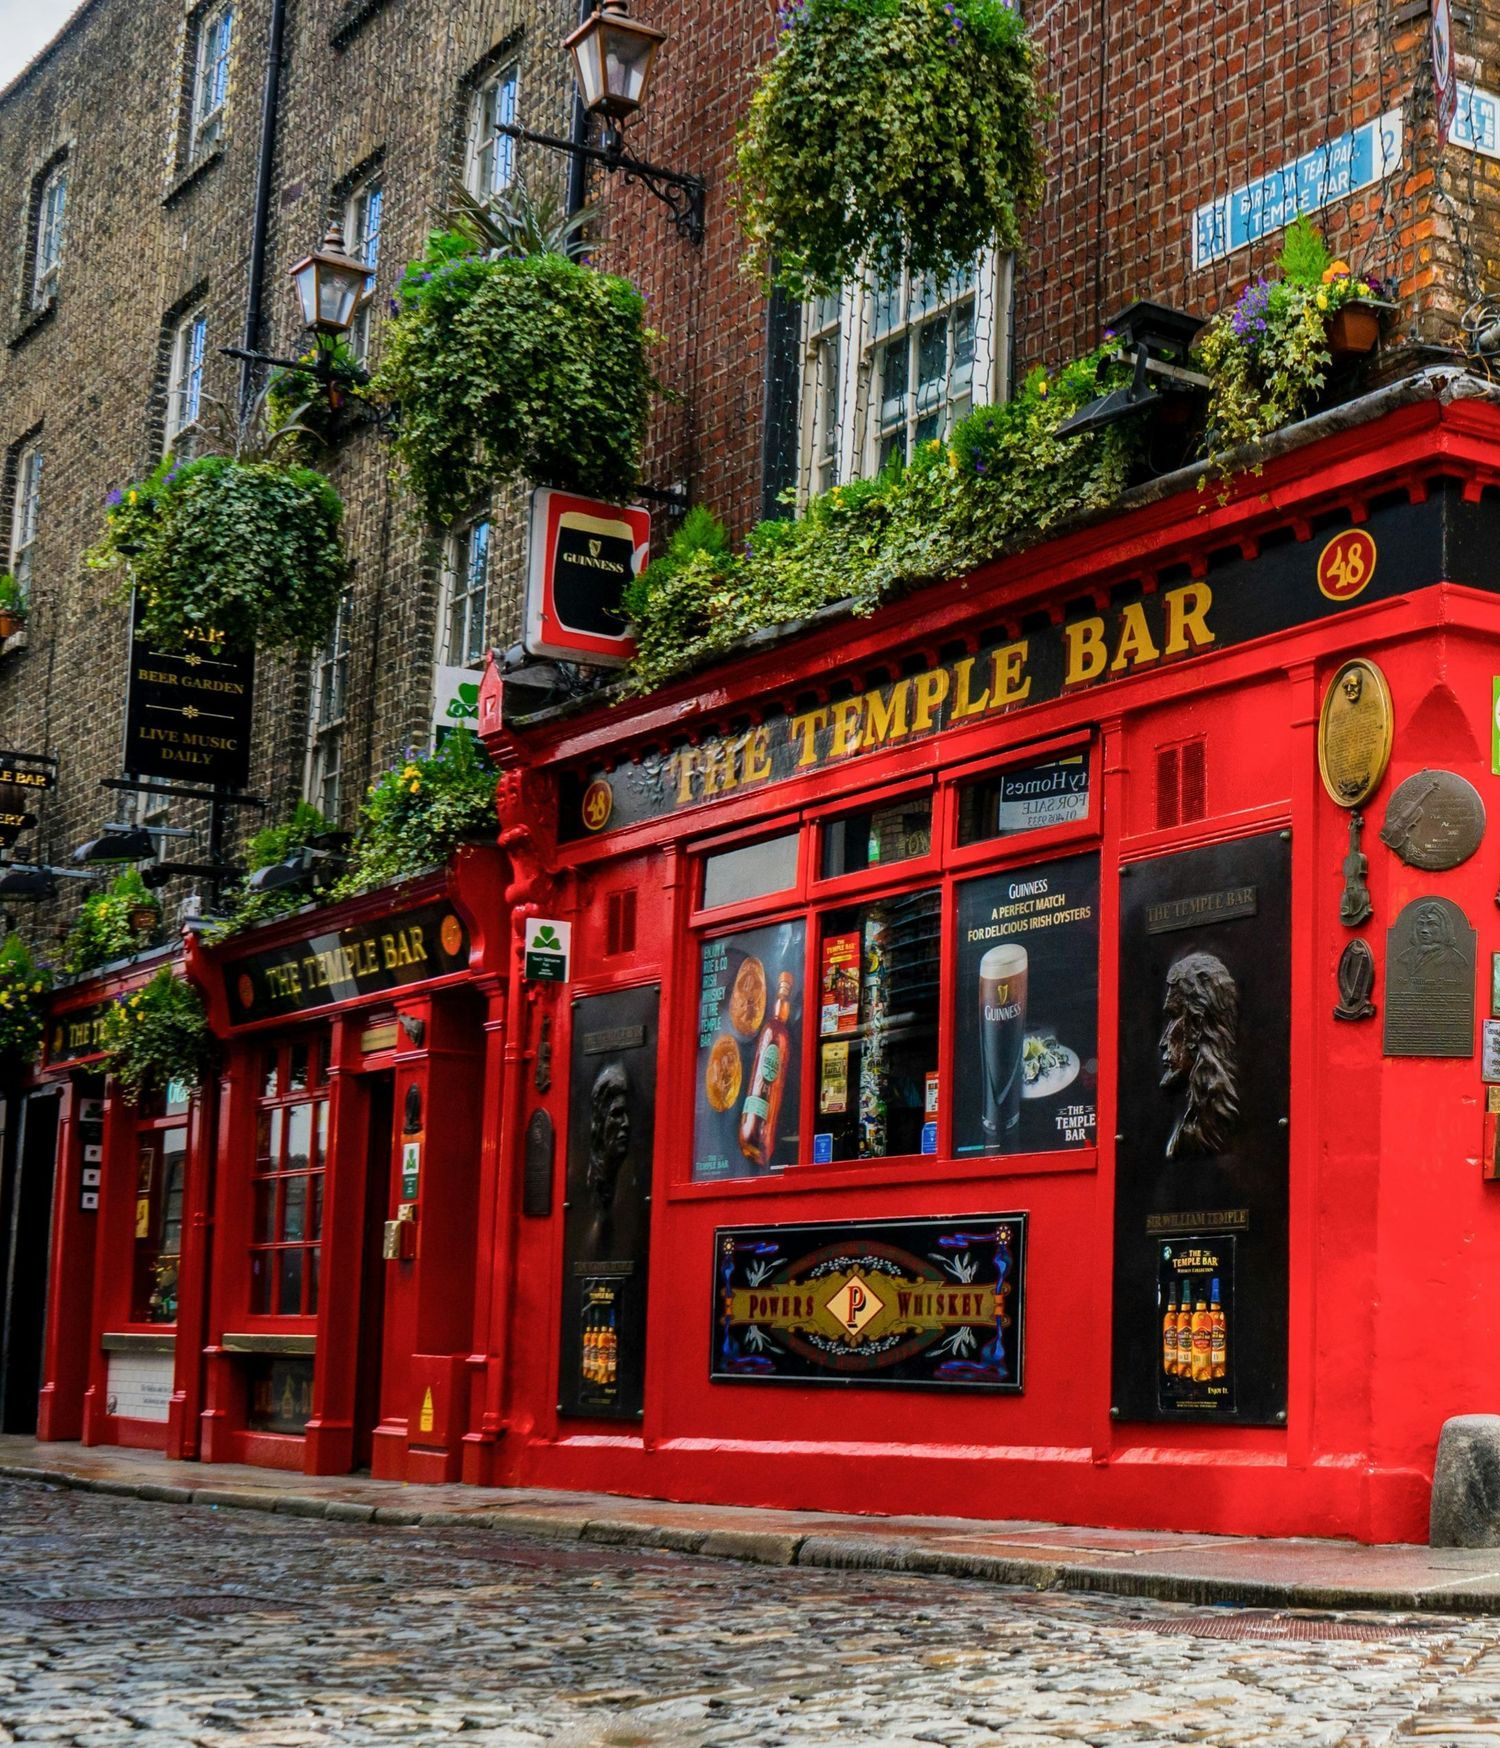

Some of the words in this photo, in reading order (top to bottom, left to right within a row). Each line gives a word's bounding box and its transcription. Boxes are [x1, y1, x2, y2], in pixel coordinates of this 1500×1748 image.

[1381, 129, 1395, 163] 2
[1253, 188, 1311, 232] TEMPLE
[563, 552, 624, 573] GUINNESS
[1326, 543, 1365, 590] 48
[138, 669, 178, 685] BEER
[181, 676, 244, 694] GARDEN
[672, 726, 772, 805] THE
[791, 640, 1033, 767] TEMPLE
[1064, 581, 1216, 687] BAR
[139, 726, 179, 743] LIVE
[183, 733, 238, 750] MUSIC
[161, 748, 214, 765] DAILY
[15, 772, 47, 787] BAR
[586, 792, 607, 822] 48
[1009, 879, 1048, 899] GUINNESS
[991, 907, 998, 921] A
[999, 900, 1034, 919] PERFECT
[1035, 894, 1065, 911] MATCH
[1147, 904, 1169, 922] THE
[1175, 895, 1223, 917] TEMPLE
[1226, 887, 1254, 907] BAR
[967, 927, 984, 942] FOR
[985, 918, 1028, 939] DELICIOUS
[1029, 913, 1052, 929] IRISH
[1053, 906, 1091, 925] OYSTERS
[264, 961, 302, 999] THE
[303, 938, 379, 990] TEMPLE
[381, 926, 429, 970] BAR
[984, 1002, 1022, 1021] GUINNESS
[1055, 1113, 1096, 1130] TEMPLE
[1067, 1105, 1084, 1116] THE
[1065, 1128, 1086, 1142] BAR
[1162, 1211, 1205, 1228] WILLIAM
[1206, 1210, 1246, 1225] TEMPLE
[1172, 1257, 1201, 1268] TEMPLE
[1202, 1257, 1218, 1266] BAR
[1189, 1249, 1202, 1257] THE
[749, 1295, 814, 1317] POWERS
[846, 1285, 866, 1324] P
[897, 1292, 984, 1317] WHISKEY
